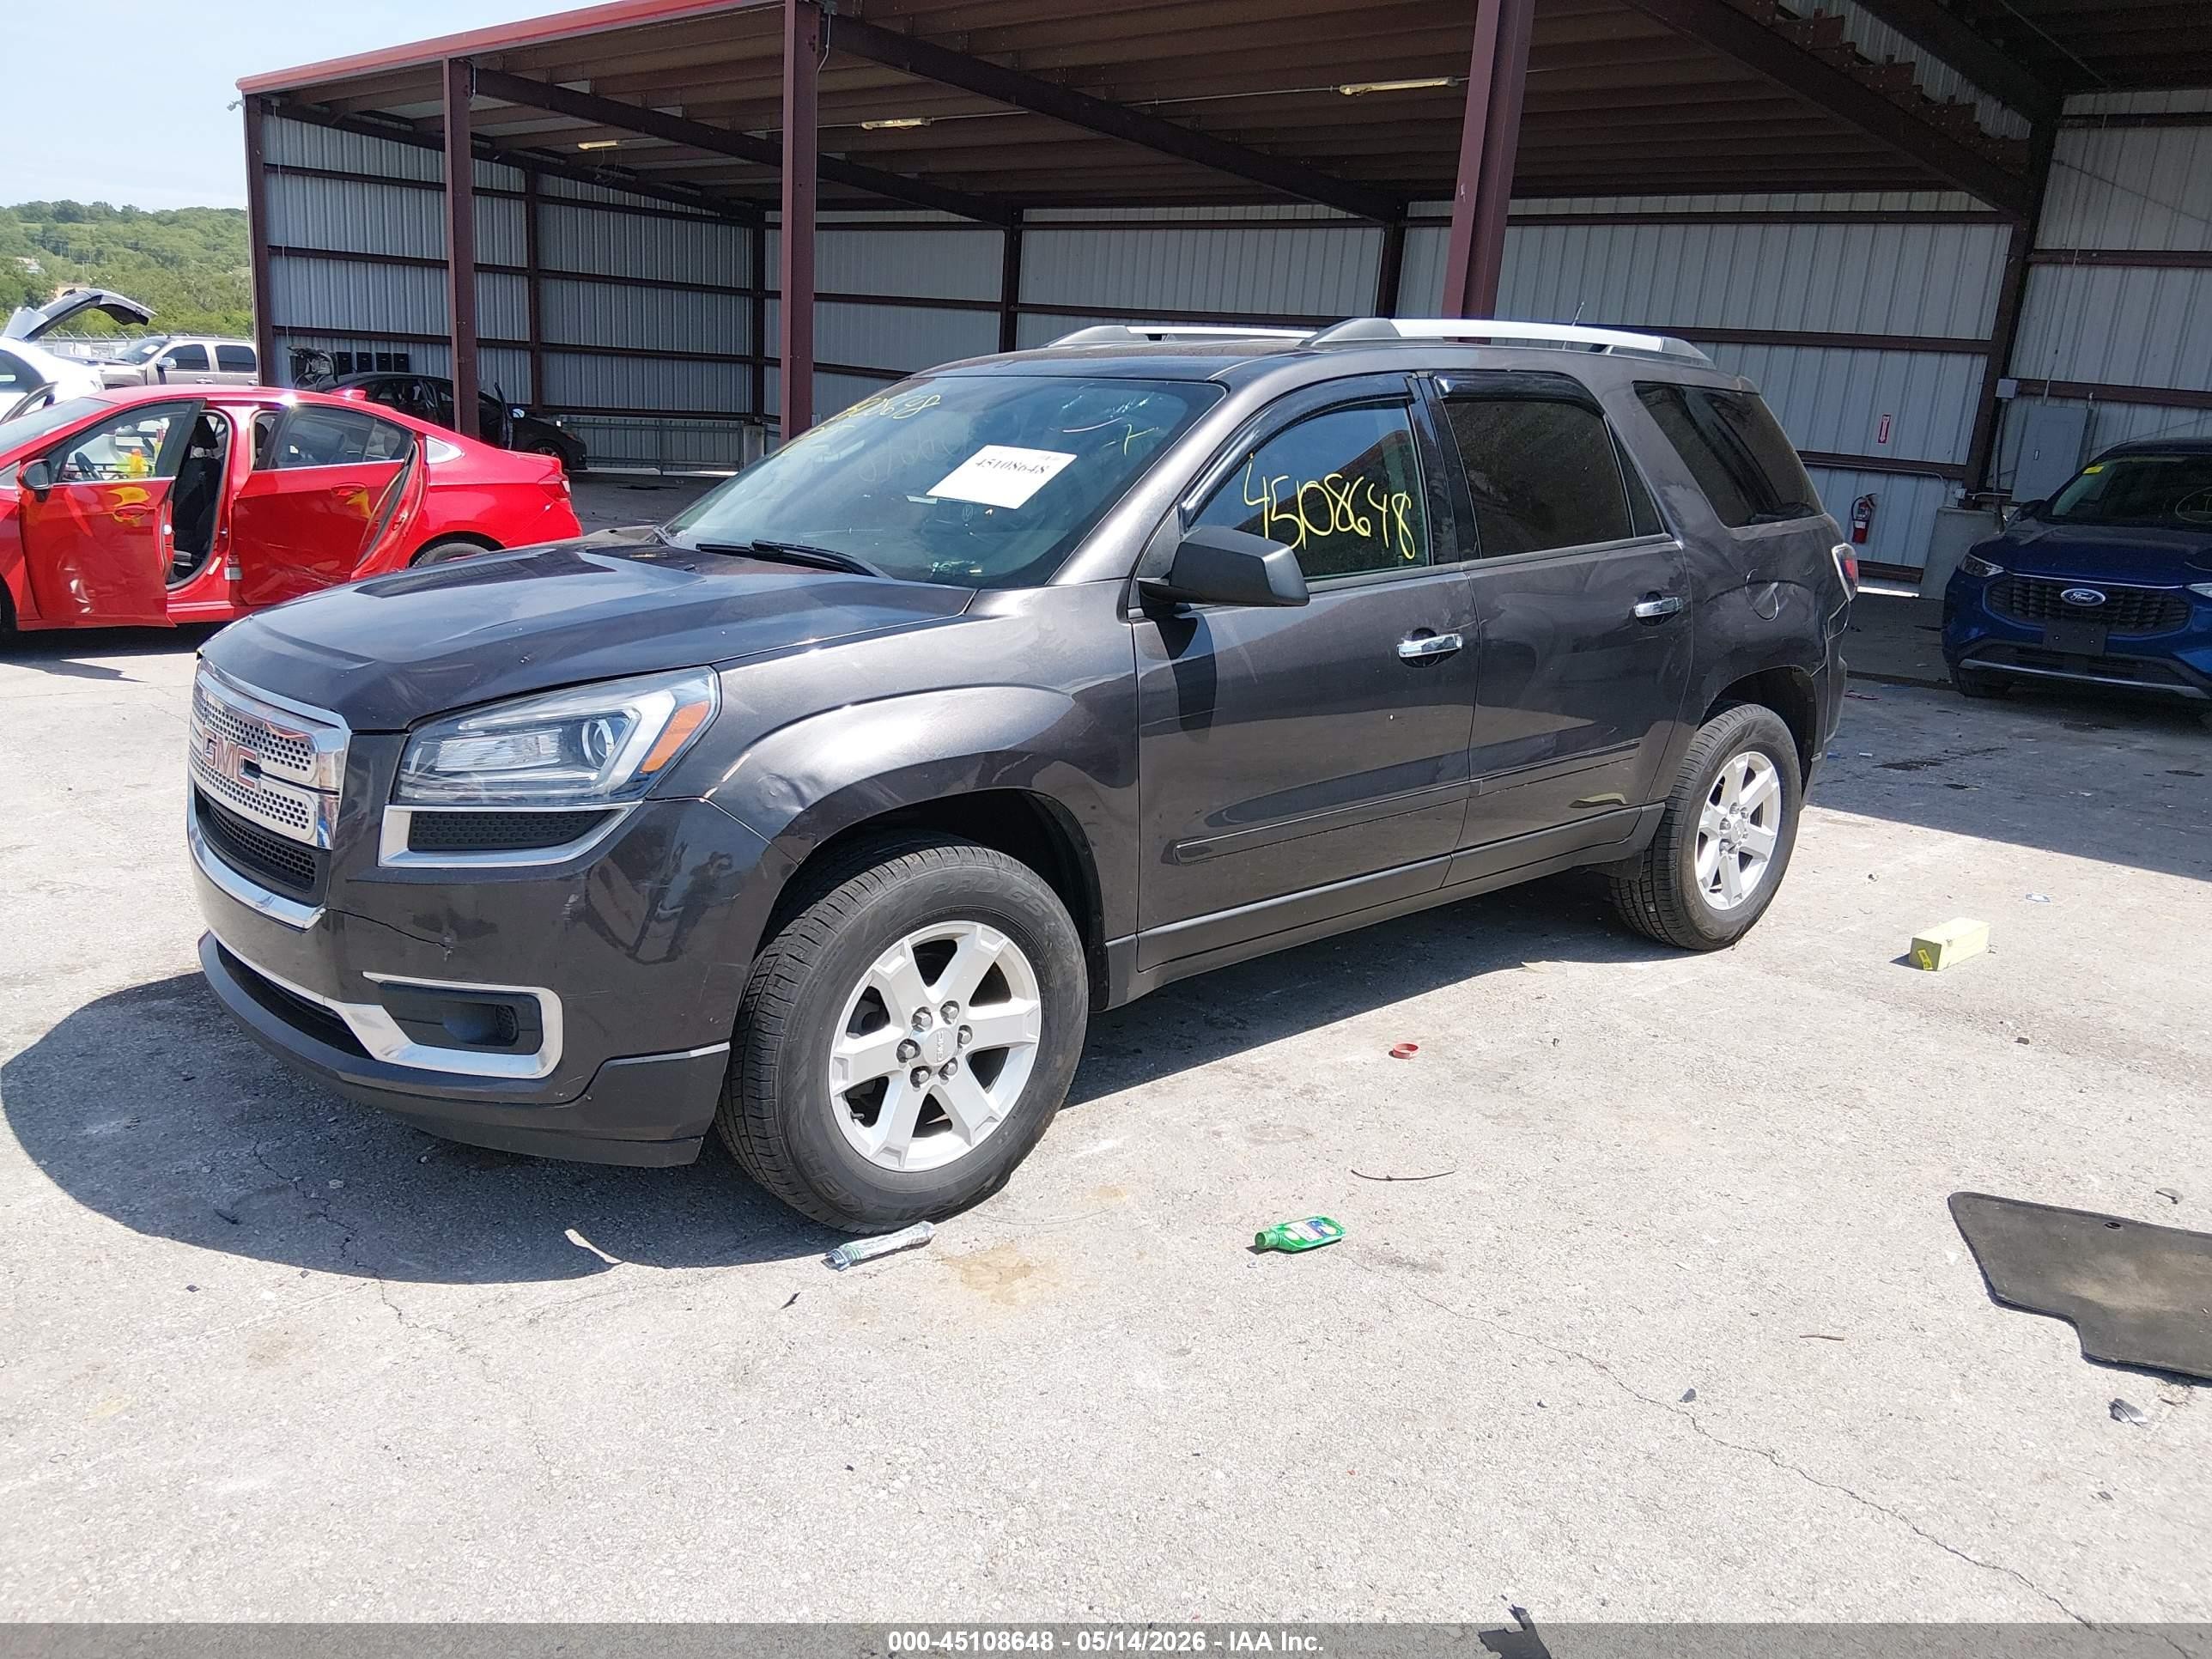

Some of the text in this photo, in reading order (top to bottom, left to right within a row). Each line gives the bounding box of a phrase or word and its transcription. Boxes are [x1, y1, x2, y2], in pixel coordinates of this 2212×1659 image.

[975, 459, 1049, 475] 45108648
[1243, 453, 1416, 560] 45108648
[203, 726, 262, 793] GMC
[935, 1030, 945, 1062] GMC
